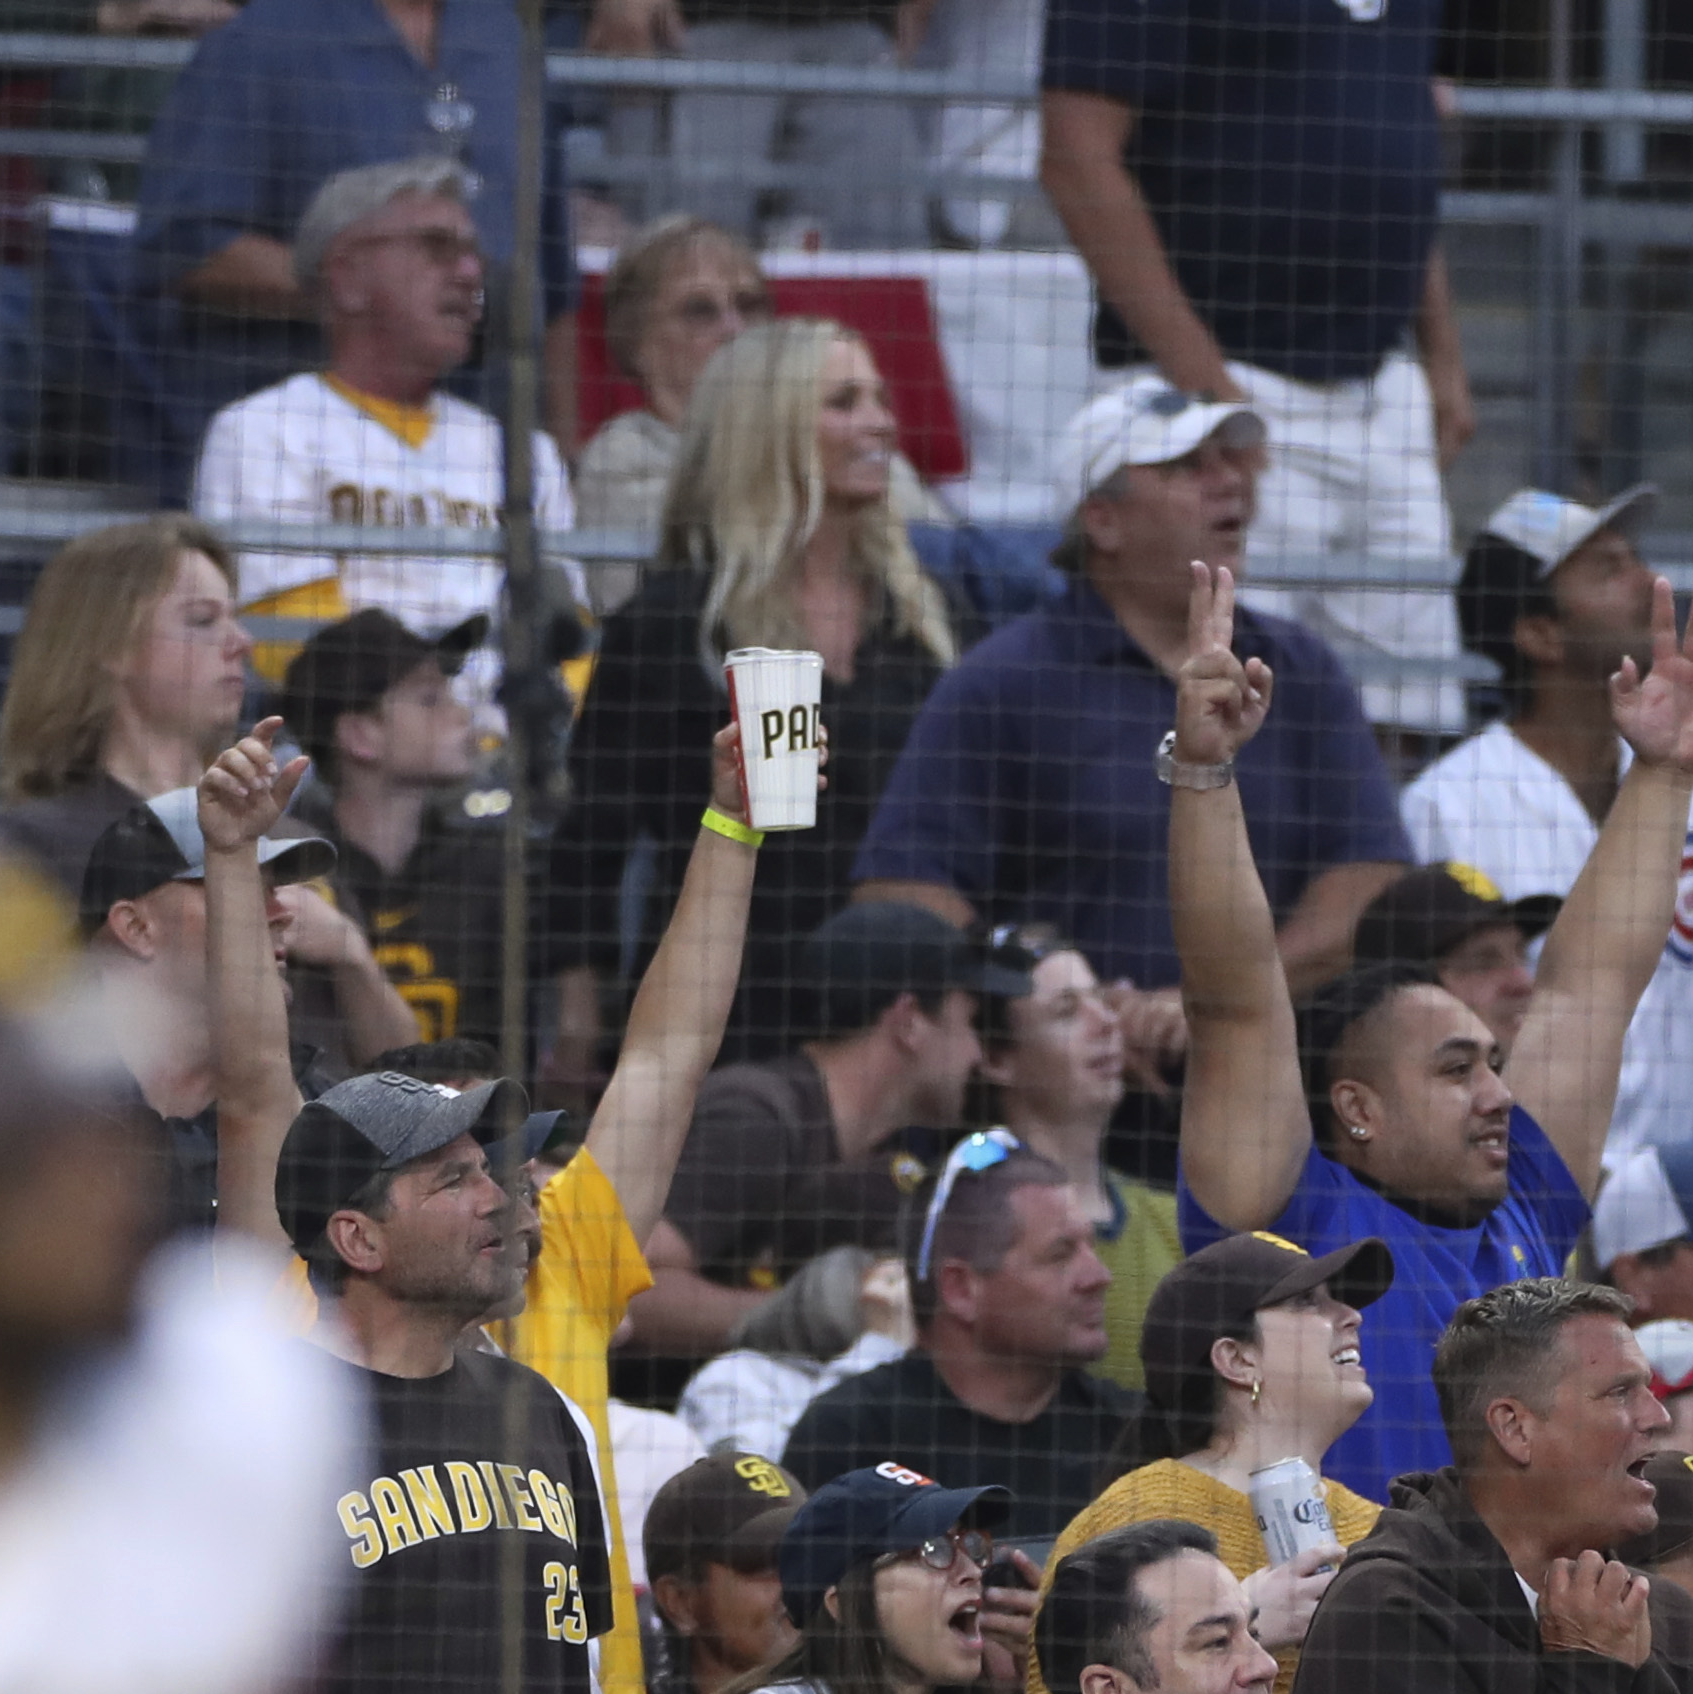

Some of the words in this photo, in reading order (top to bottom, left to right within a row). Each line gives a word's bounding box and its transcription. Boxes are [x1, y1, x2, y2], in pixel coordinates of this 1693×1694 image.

[336, 1464, 457, 1568] SAN
[735, 1456, 791, 1498] SD
[543, 1561, 588, 1645] 23
